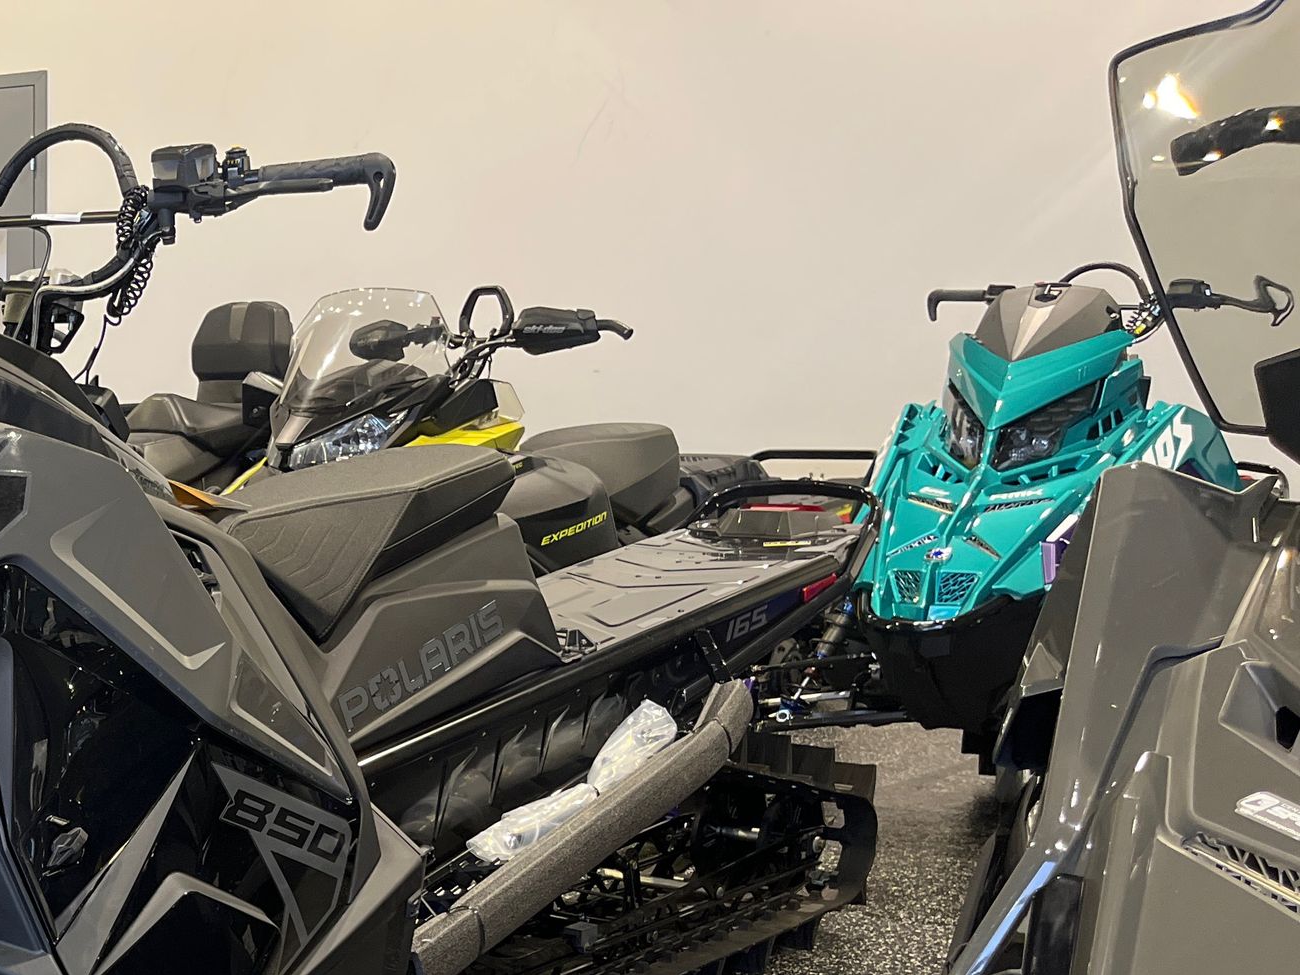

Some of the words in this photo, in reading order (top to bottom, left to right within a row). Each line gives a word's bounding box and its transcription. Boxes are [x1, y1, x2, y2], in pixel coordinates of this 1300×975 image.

[541, 511, 608, 546] EXPEDITION
[726, 604, 768, 642] 165
[337, 599, 504, 731] POLARIS
[221, 788, 346, 864] 850
